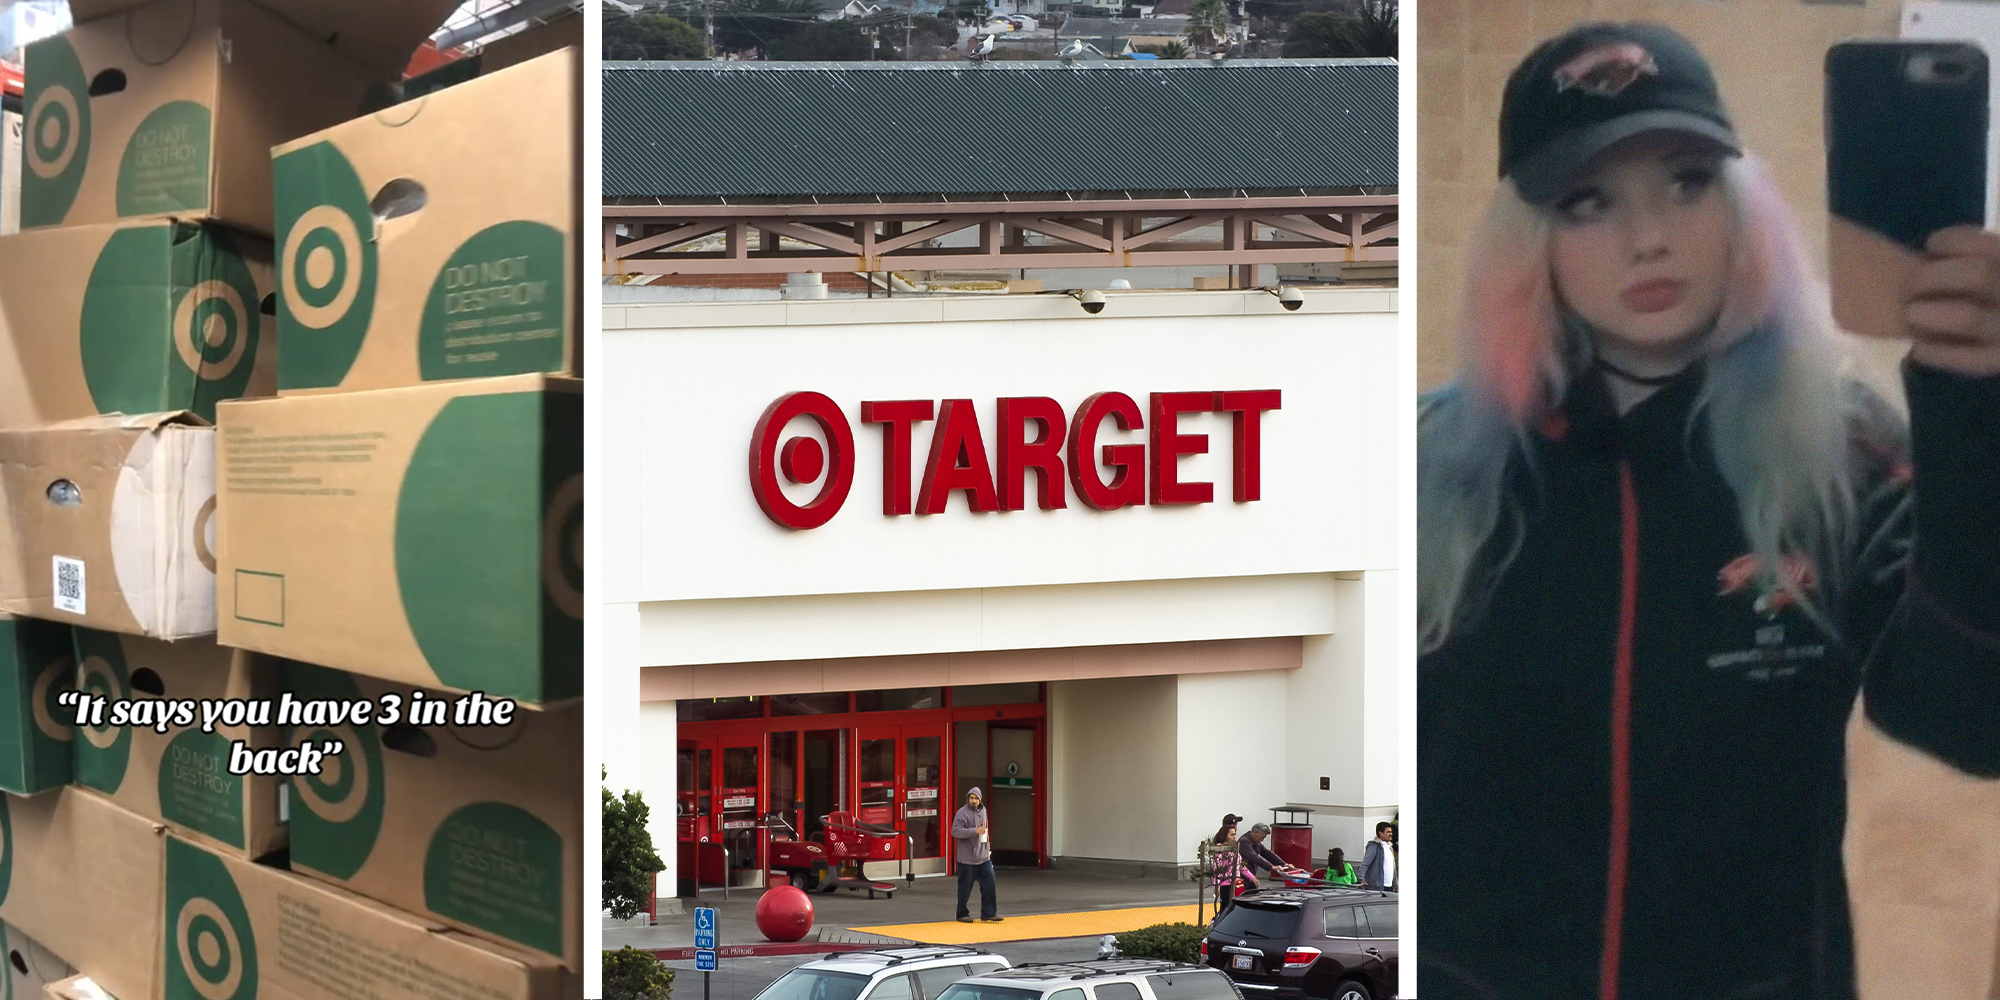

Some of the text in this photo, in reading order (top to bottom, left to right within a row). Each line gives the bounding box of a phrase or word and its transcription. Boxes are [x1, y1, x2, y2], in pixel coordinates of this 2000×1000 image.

[445, 255, 529, 289] DO NOT
[445, 280, 549, 314] DESTROY
[861, 389, 1282, 516] TARGET
[172, 745, 220, 773] DO NOT
[174, 763, 232, 795] DESTROY
[695, 928, 713, 937] PARKING
[697, 938, 711, 946] ONLY
[730, 947, 754, 955] PARKING
